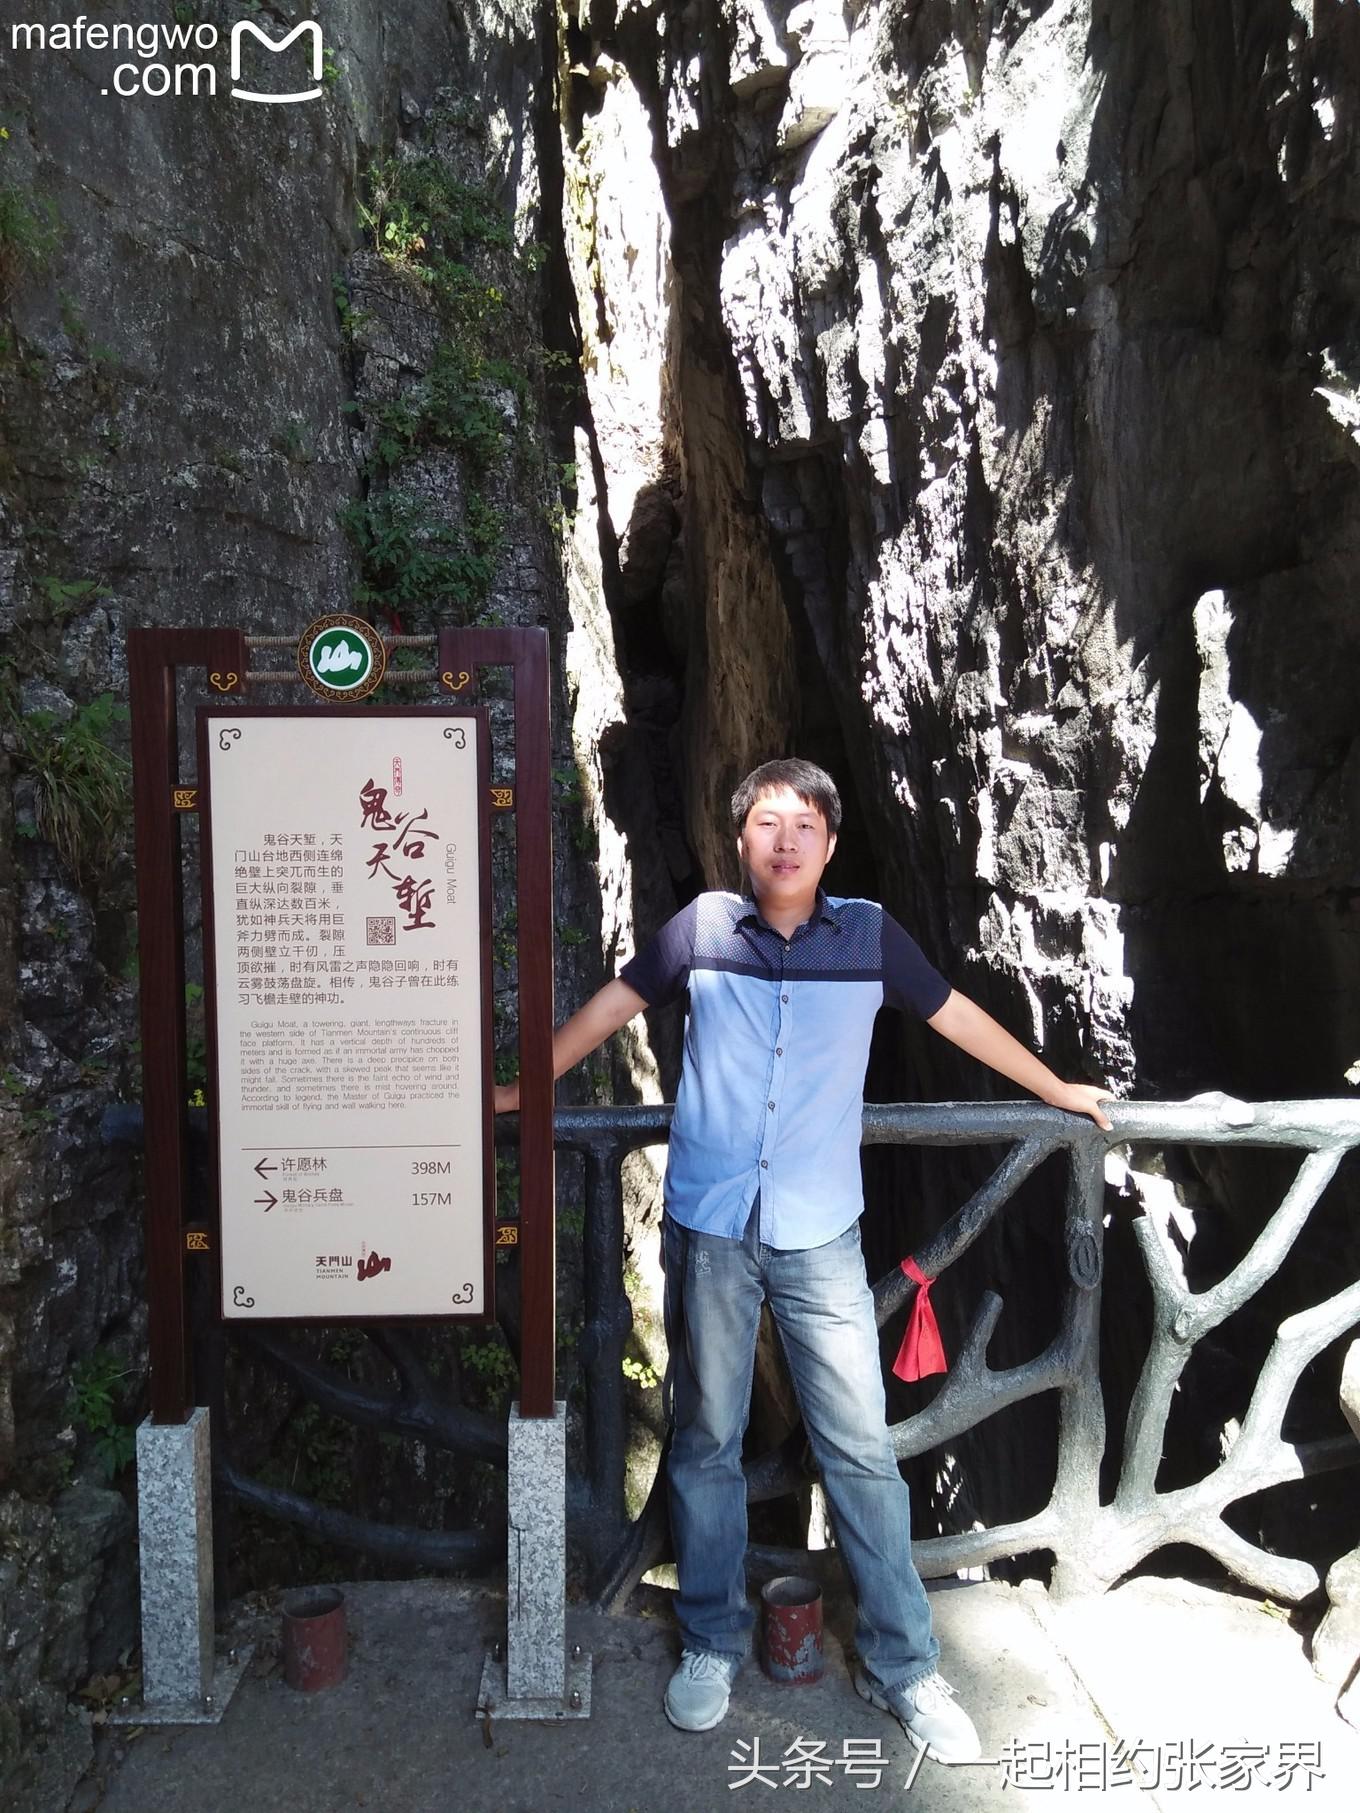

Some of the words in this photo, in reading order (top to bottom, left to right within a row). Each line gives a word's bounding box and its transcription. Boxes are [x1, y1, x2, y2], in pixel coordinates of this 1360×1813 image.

[263, 833, 343, 846] 鬼谷天堑，天
[234, 849, 343, 862] 门山台地西侧连绵
[445, 843, 456, 874] Guigu
[234, 865, 344, 878] 绝壁上突兀而生的
[235, 881, 344, 894] 巨大纵向裂隙，垂
[447, 878, 456, 904] Moat
[236, 898, 341, 911] 直纵深达数百米，
[236, 913, 344, 926] 犹如神兵天将用巨
[237, 992, 345, 1006] 习飞檐走壁的神功。
[251, 1021, 273, 1030] Guigu
[375, 1019, 416, 1028] lengthways
[401, 1027, 441, 1035] continuous
[372, 1037, 392, 1046] depth
[411, 1036, 445, 1044] hundreds
[295, 1047, 321, 1055] formed
[356, 1046, 387, 1054] immortal
[426, 1045, 459, 1054] chopped
[241, 1057, 245, 1065] it
[278, 1057, 297, 1066] huge
[367, 1055, 386, 1064] deep
[391, 1055, 424, 1064] precipice
[241, 1066, 260, 1074] sides
[316, 1065, 331, 1073] with
[374, 1064, 392, 1073] peak
[455, 1063, 459, 1071] it
[241, 1076, 261, 1085] might
[392, 1073, 410, 1081] echo
[395, 1082, 426, 1091] hovering
[242, 1094, 279, 1103] According
[384, 1092, 406, 1101] Guigu
[410, 1091, 444, 1100] practiced
[276, 1102, 289, 1110] skill
[303, 1102, 322, 1111] flying
[342, 1101, 356, 1109] wall
[359, 1101, 385, 1110] walking
[281, 1157, 327, 1172] 许愿林
[411, 1161, 451, 1175] 398M
[282, 1188, 344, 1204] 鬼谷兵盘
[411, 1192, 452, 1206] 157M
[315, 1256, 353, 1267] 天門山
